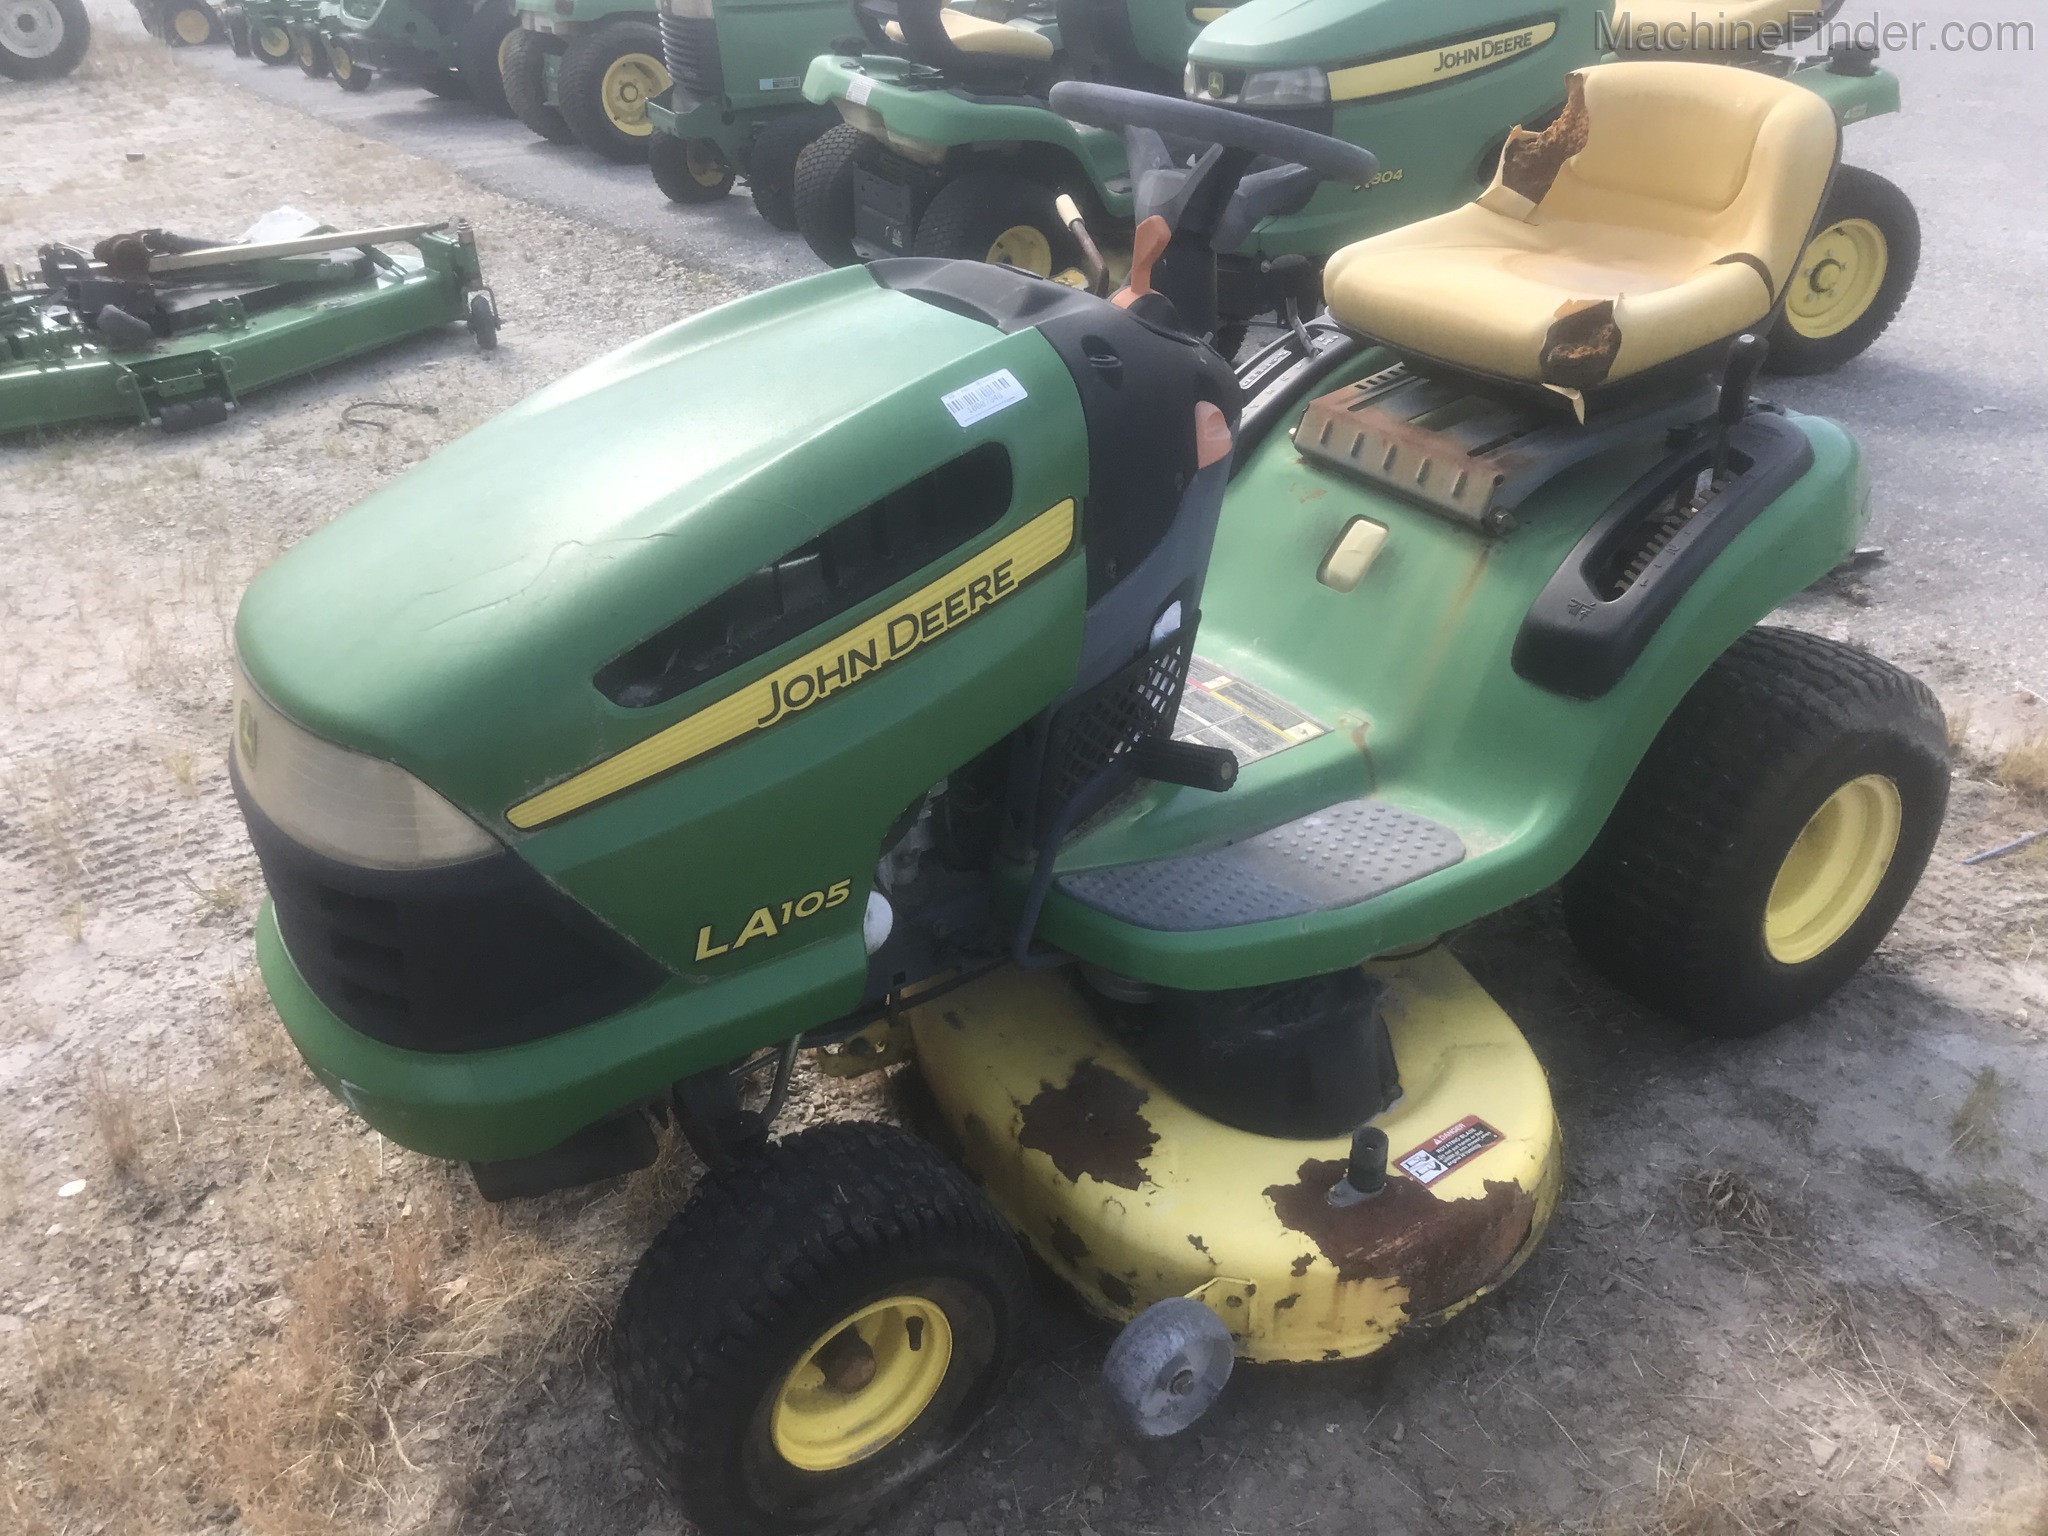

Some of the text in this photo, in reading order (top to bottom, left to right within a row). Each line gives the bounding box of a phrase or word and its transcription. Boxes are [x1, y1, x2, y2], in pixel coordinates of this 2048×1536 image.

[1434, 32, 1532, 72] JOHN DEERE
[1353, 169, 1403, 190] 304
[758, 559, 1015, 725] JOHN DEERE
[695, 878, 852, 961] LA105
[1438, 1123, 1466, 1140] DANGER
